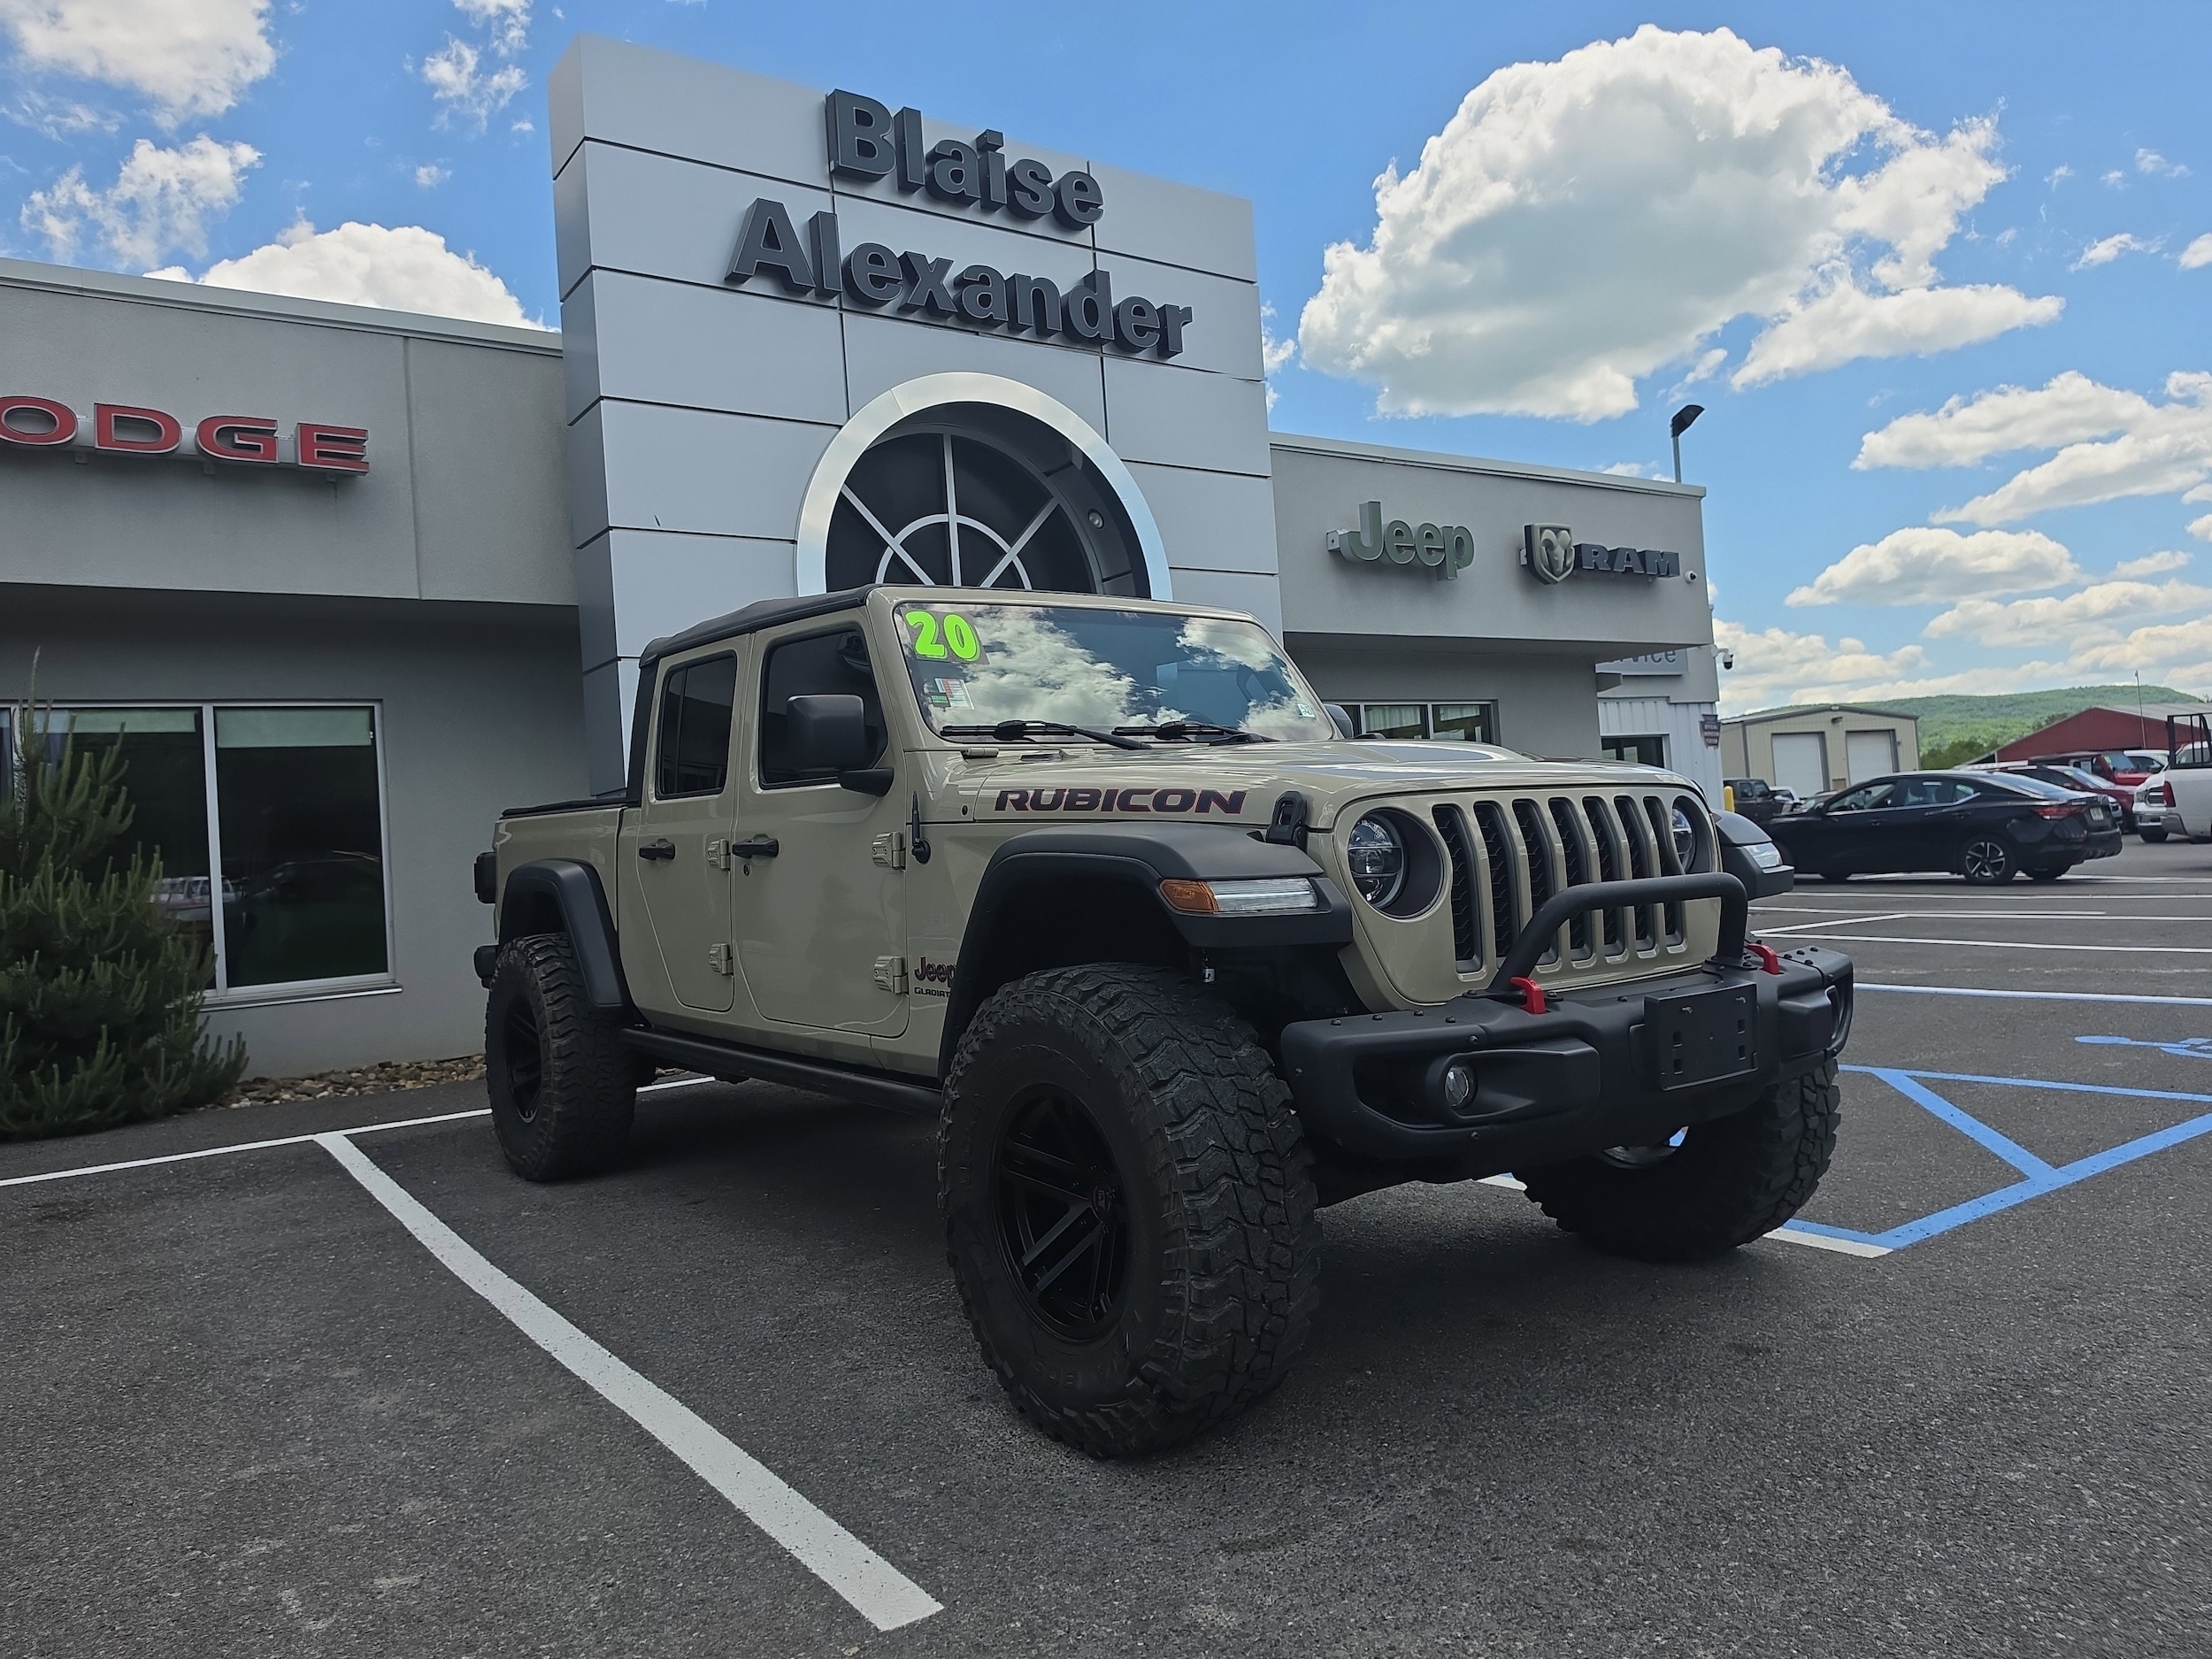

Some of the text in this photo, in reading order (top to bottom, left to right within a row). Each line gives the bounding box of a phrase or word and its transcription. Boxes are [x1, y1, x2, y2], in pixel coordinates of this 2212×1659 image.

[825, 88, 1104, 230] Blaise
[725, 198, 1193, 358] Alexander
[0, 396, 369, 475] ODGE
[1340, 501, 1475, 580] Jeep
[1576, 543, 1680, 579] RAM
[905, 611, 980, 662] 20
[994, 788, 1248, 814] RUBICON
[914, 956, 957, 988] Jeep
[914, 987, 951, 998] GLADIAT
